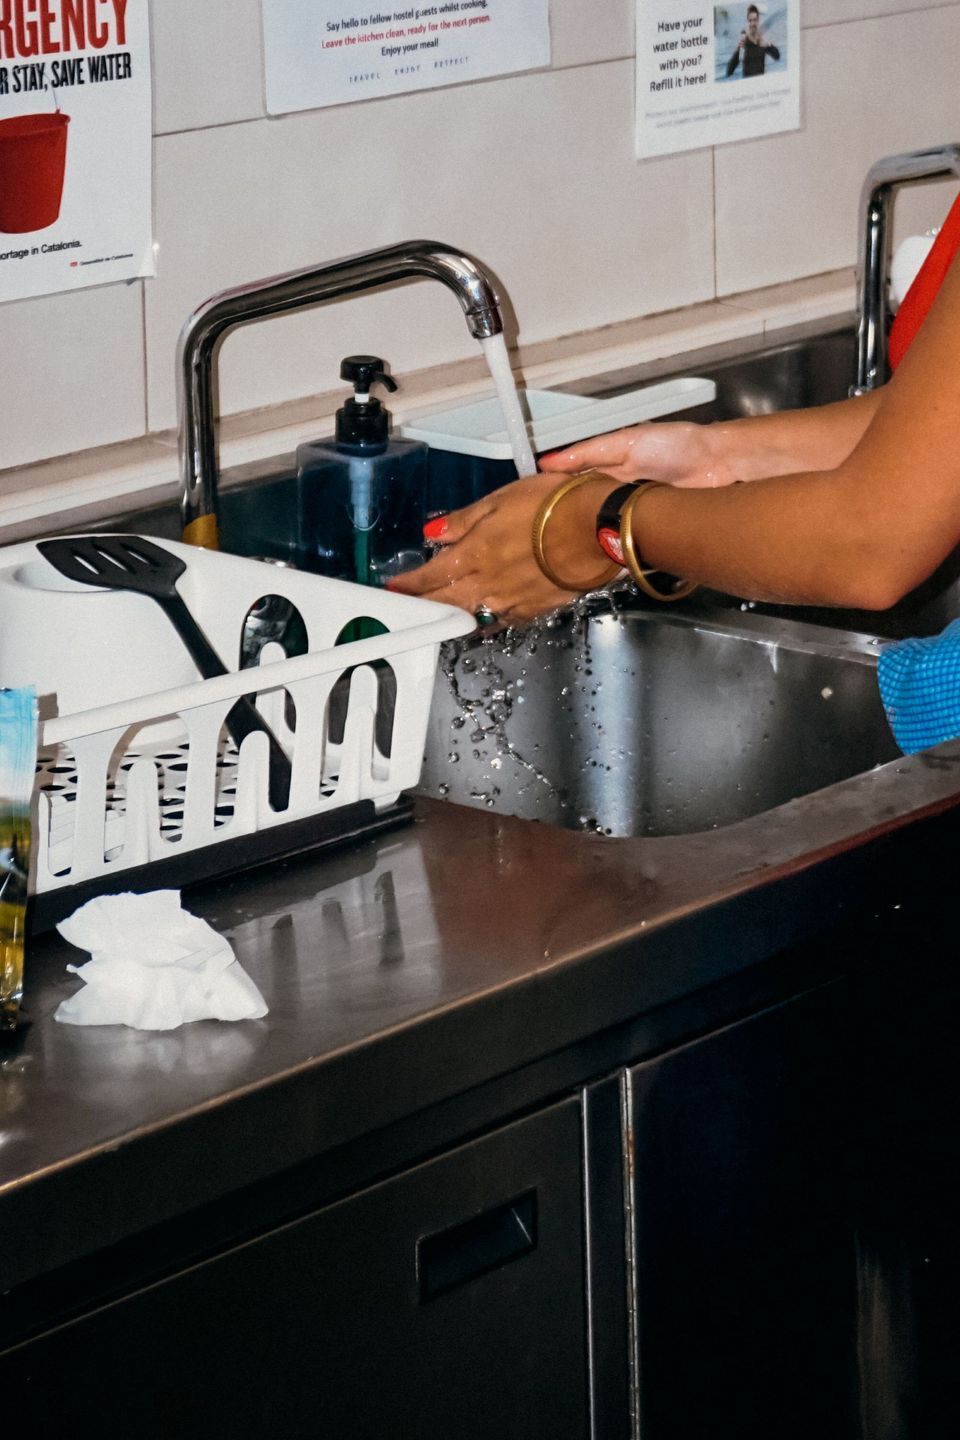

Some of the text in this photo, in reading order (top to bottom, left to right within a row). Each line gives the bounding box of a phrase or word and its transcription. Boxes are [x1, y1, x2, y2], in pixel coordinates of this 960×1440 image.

[326, 22, 340, 33] Say
[342, 18, 359, 29] hello
[361, 17, 368, 26] to
[370, 13, 392, 25] fellow
[393, 8, 414, 21] hostel
[415, 7, 438, 20] guests
[439, 2, 459, 13] whilst
[657, 18, 703, 33] Have your
[321, 38, 343, 49] Leave
[345, 34, 356, 45] the
[357, 30, 384, 43] kitchen
[386, 27, 407, 39] clean,
[408, 24, 427, 36] ready
[428, 21, 439, 31] for
[440, 19, 451, 29] the
[453, 16, 468, 27] next
[381, 46, 402, 58] Enjoy
[403, 43, 418, 54] your
[653, 35, 708, 53] water bottle
[659, 54, 702, 71] with you?
[12, 62, 48, 94] STAY,
[51, 58, 84, 89] SAVE
[88, 52, 132, 82] WATER
[650, 73, 707, 92] Refill it here!
[0, 239, 83, 261] ortage in Catalonia.
